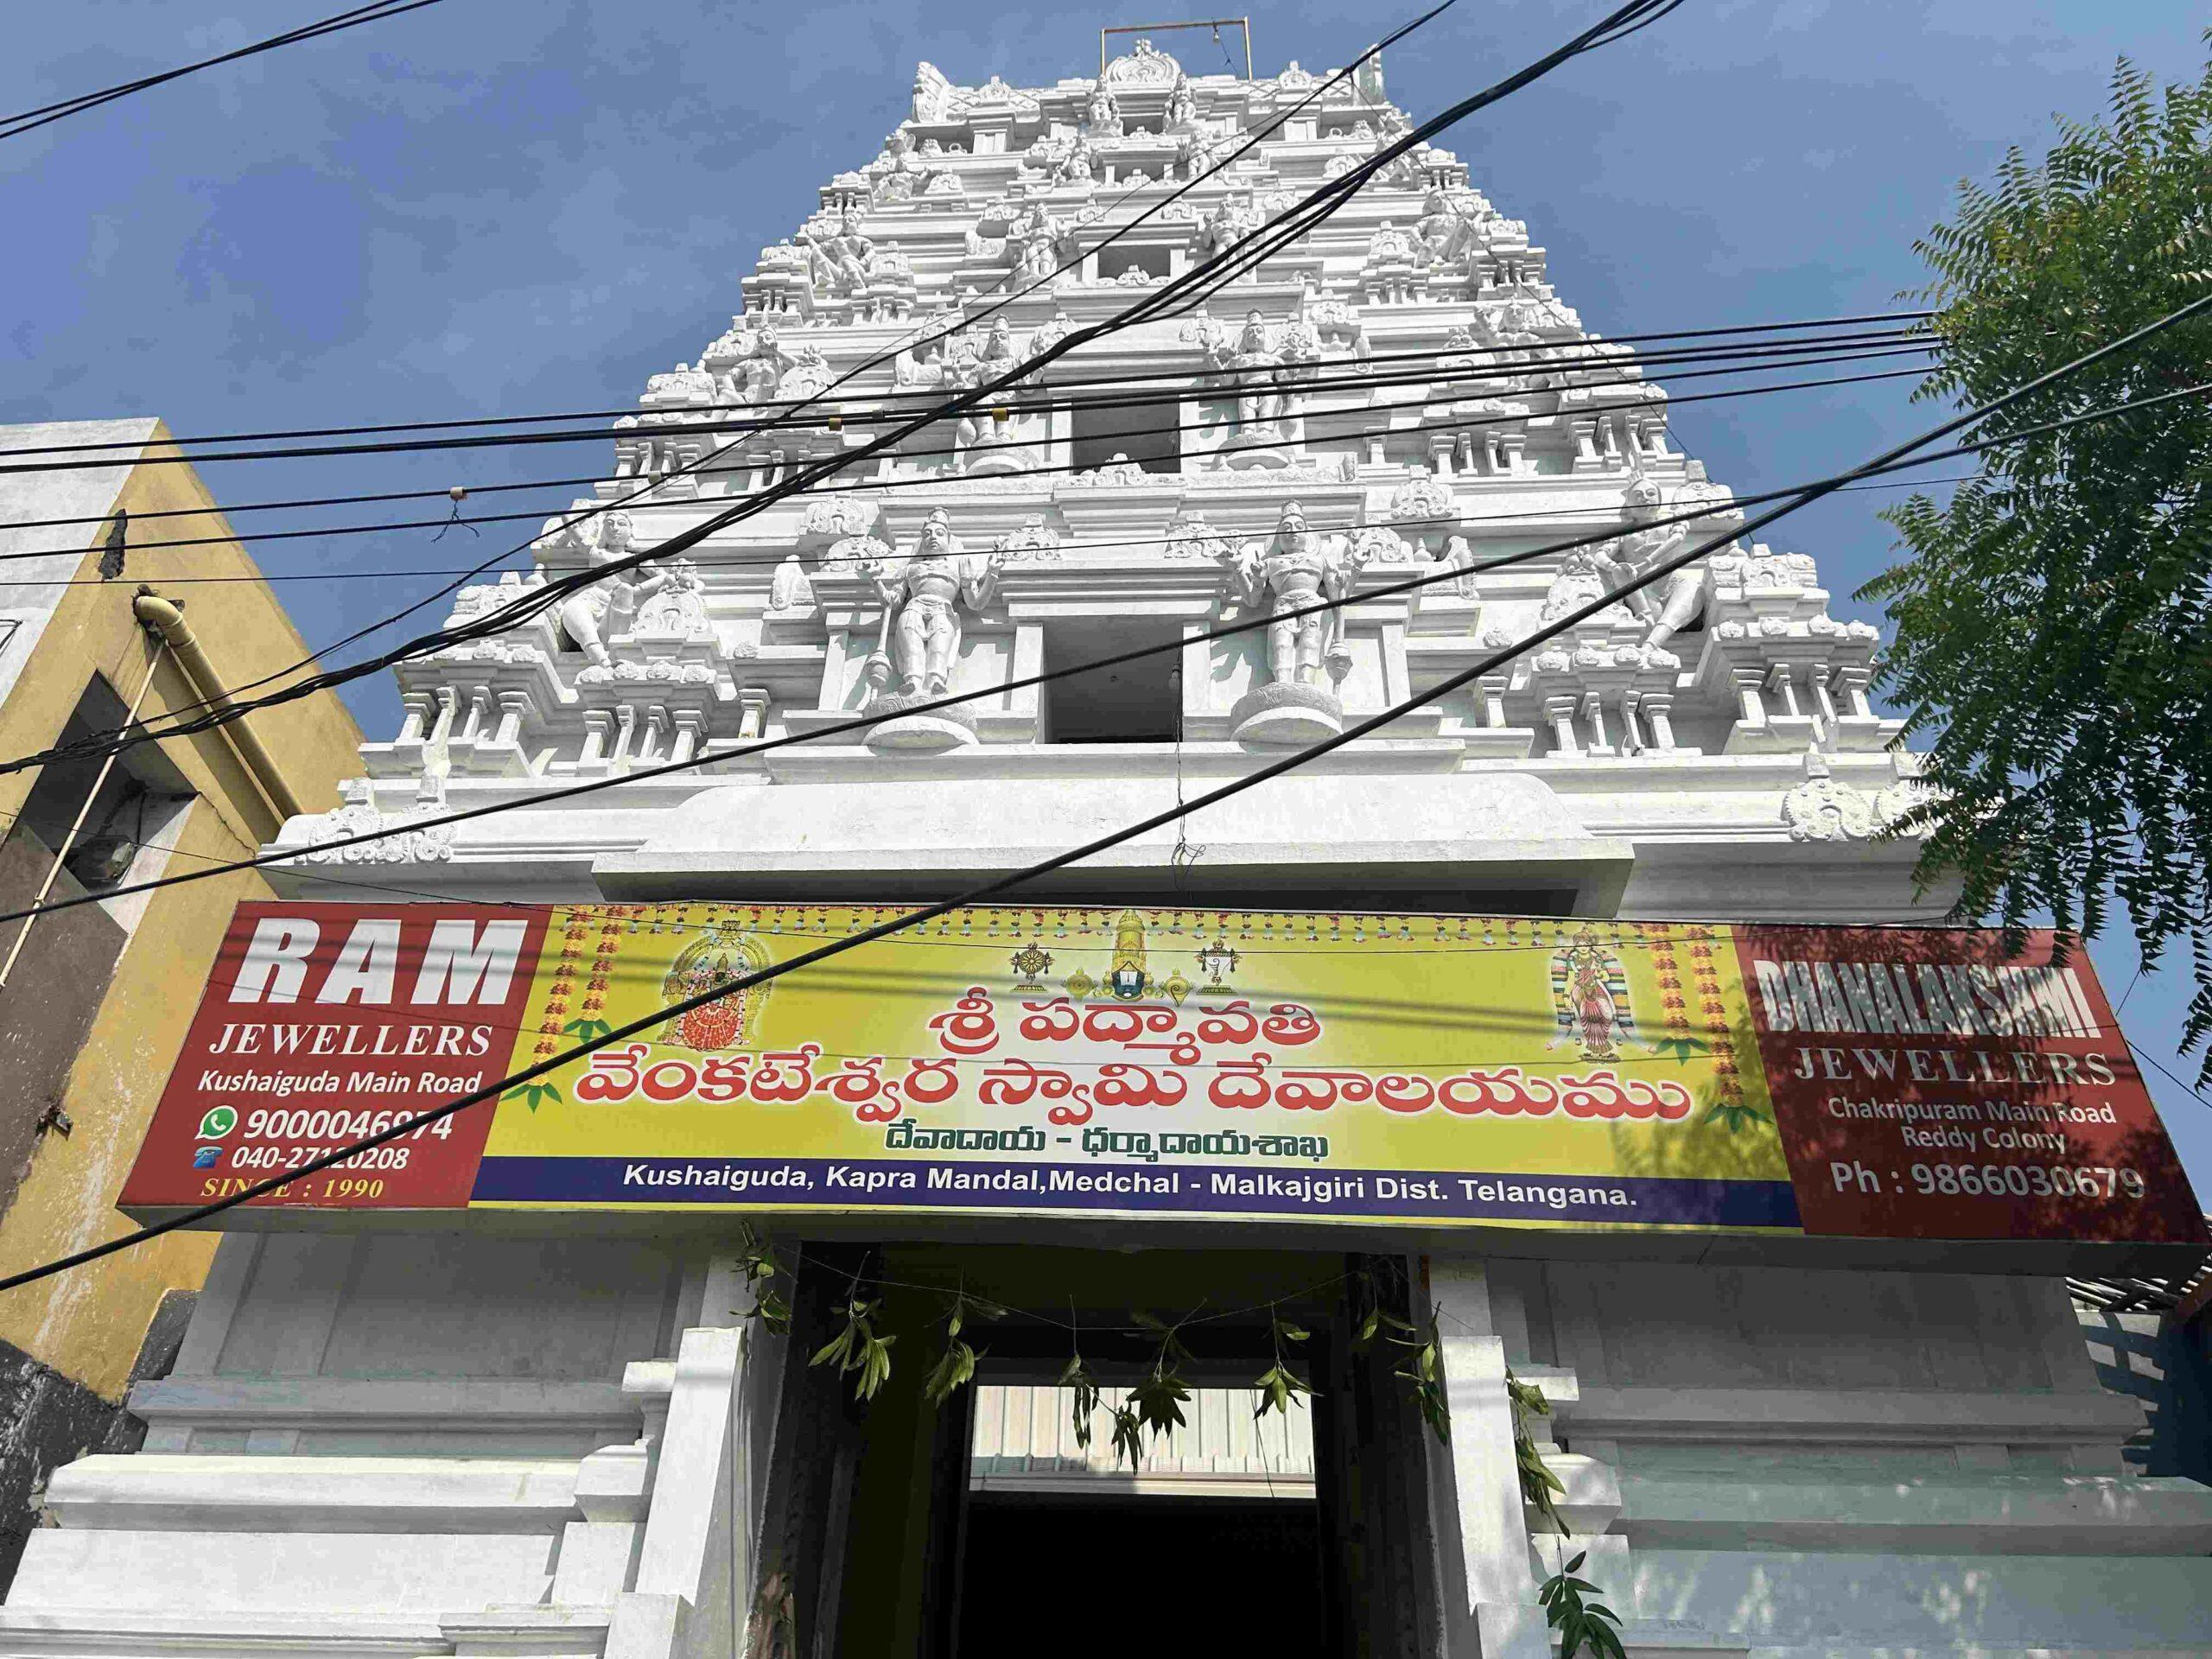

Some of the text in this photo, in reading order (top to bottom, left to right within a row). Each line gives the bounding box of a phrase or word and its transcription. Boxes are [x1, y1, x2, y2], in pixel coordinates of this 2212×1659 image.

[227, 918, 528, 1005] RAM
[1753, 959, 2101, 1038] DHANALAKSHMI
[208, 1023, 493, 1056] JEWELLERS
[929, 986, 1321, 1066] శ్రీ పద్మావతి
[198, 1070, 483, 1096] Kushaiguda Main Road
[576, 1044, 1691, 1125] వేంకటేశ్వర స్వామి దేవాలయము
[1795, 1046, 2116, 1086] JEWELLERS
[1827, 1096, 2117, 1123] Chakripuram Main Road
[886, 1118, 1046, 1150] దేవాదాయ
[1905, 1124, 2066, 1154] Reddy Colony
[322, 1179, 384, 1198] 1990
[623, 1165, 815, 1192] Kushaiguda,
[826, 1166, 916, 1192] Kapra
[1211, 1173, 1364, 1202] Malkajgiri
[1376, 1177, 1449, 1200] Dist.
[1459, 1179, 1637, 1208] Telangana.
[1830, 1160, 1880, 1193] Ph
[1912, 1163, 2145, 1198] 9866030679
